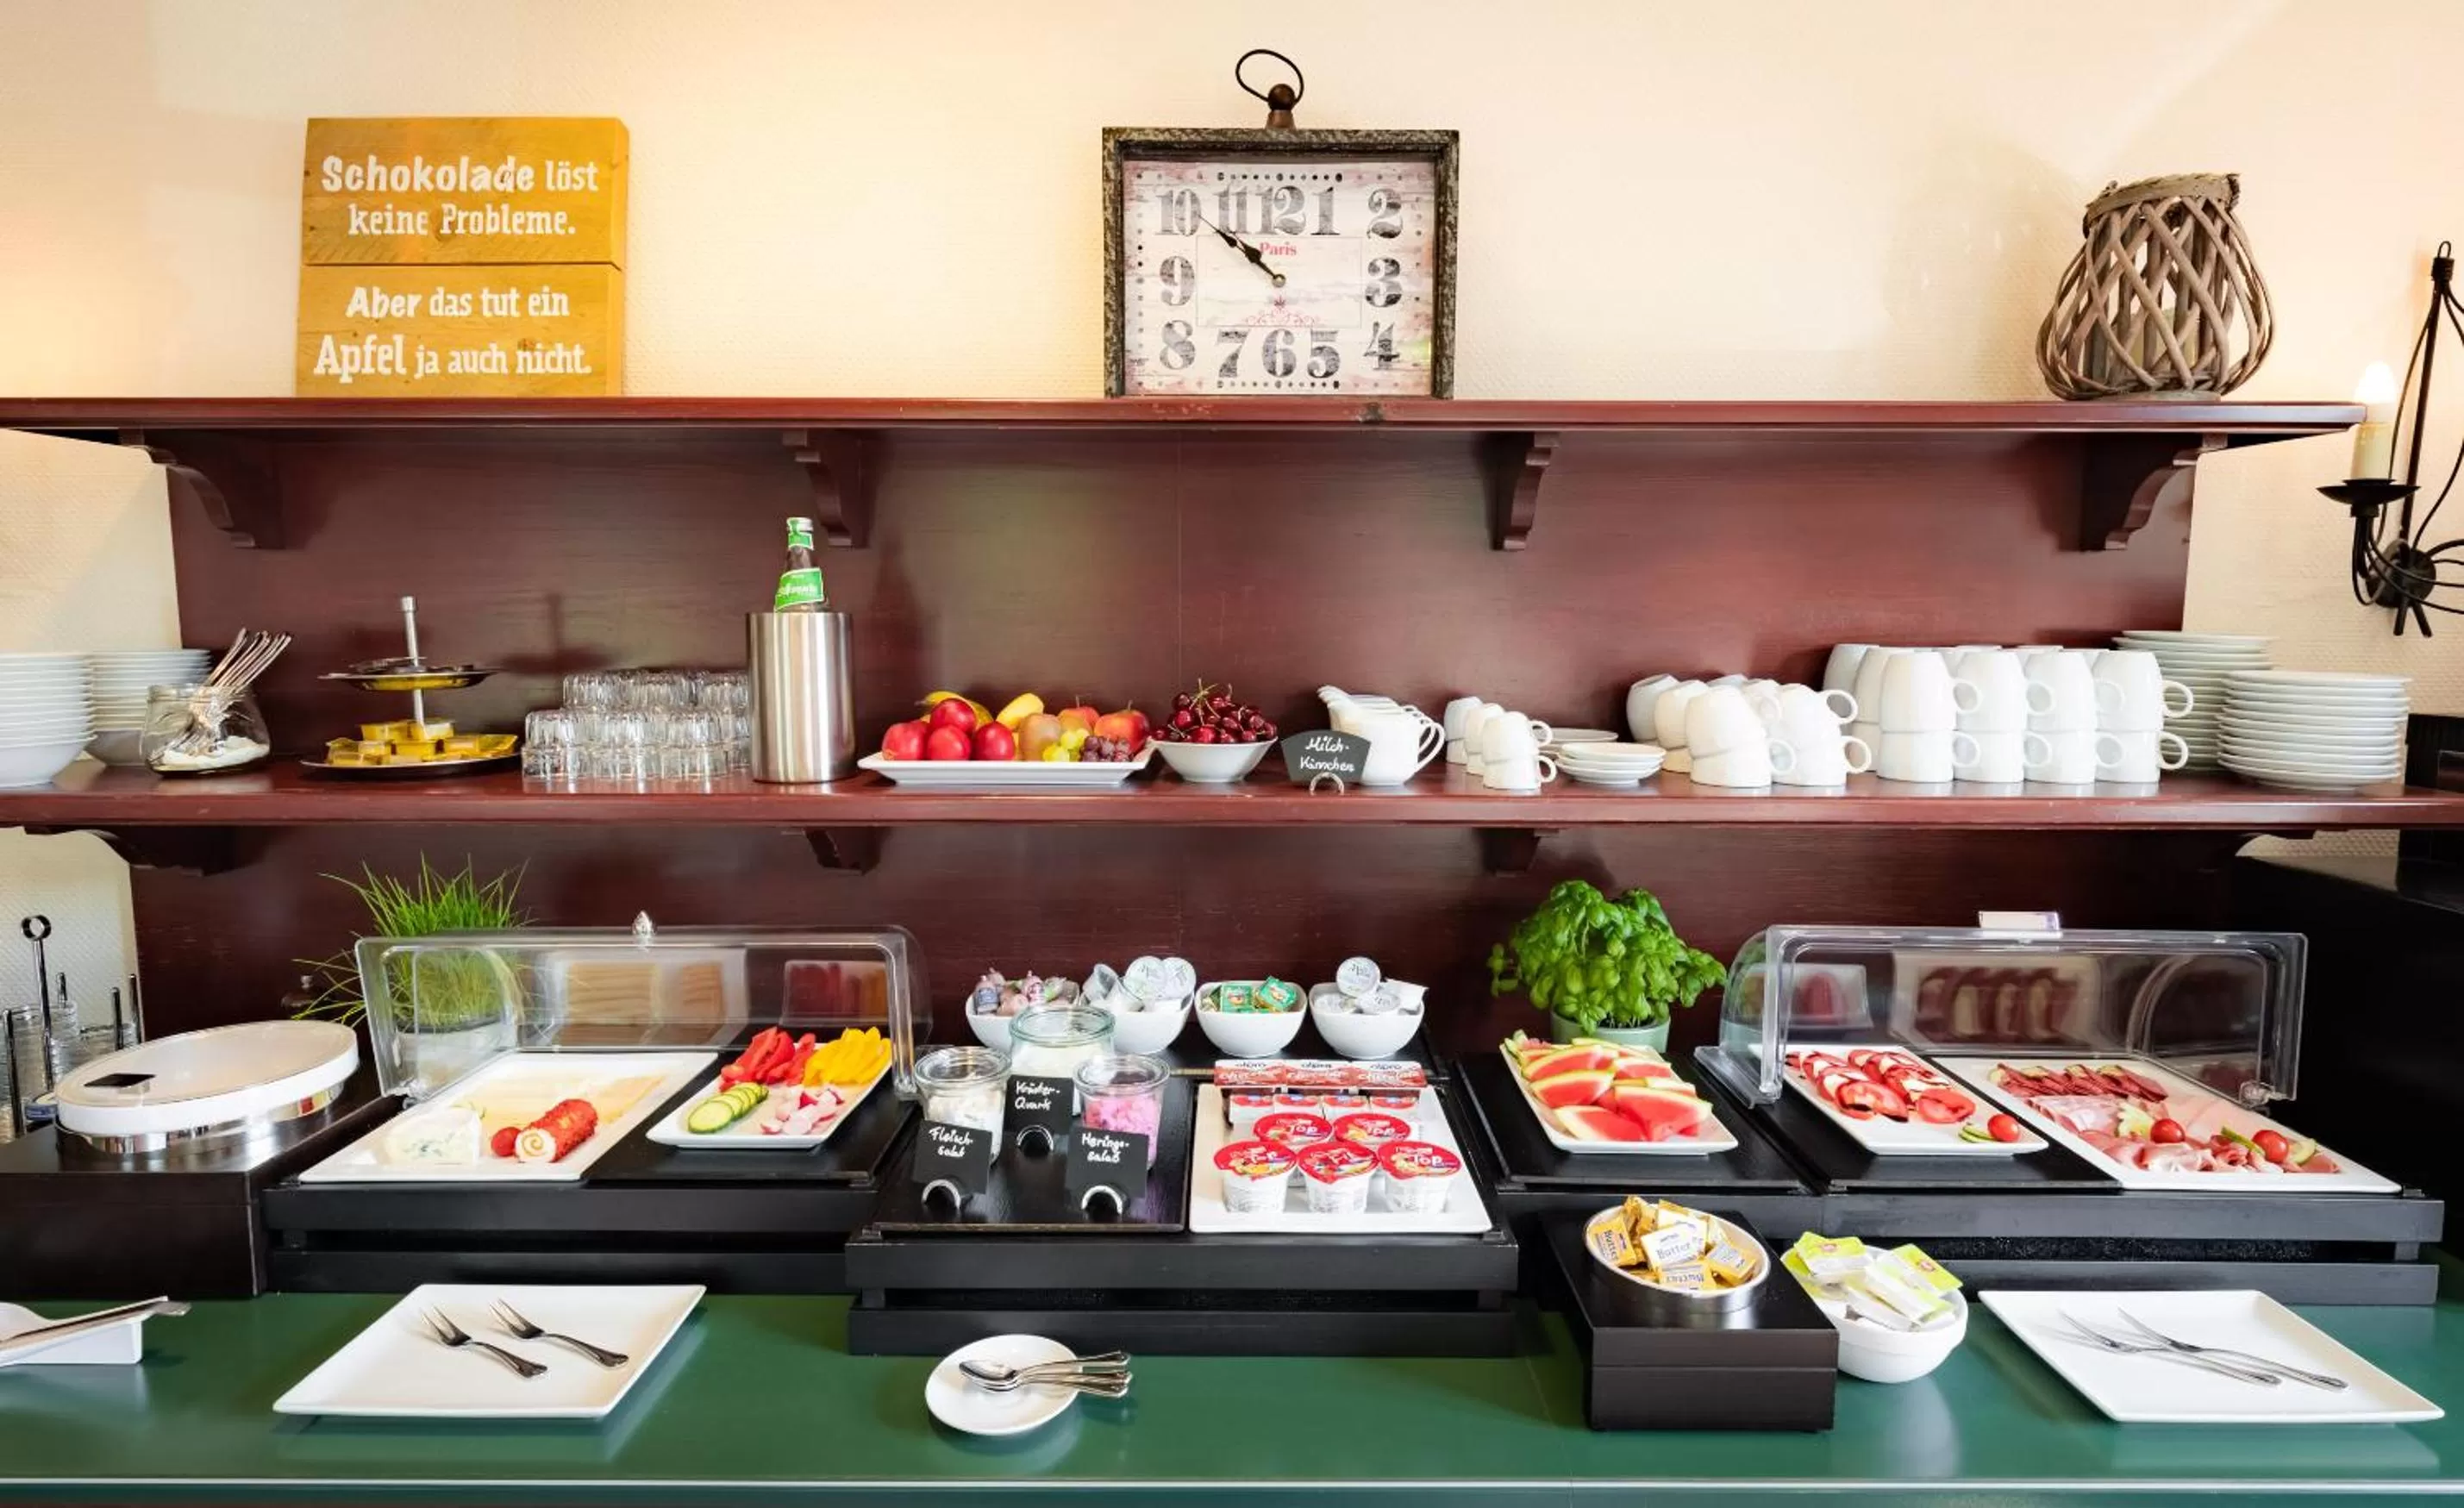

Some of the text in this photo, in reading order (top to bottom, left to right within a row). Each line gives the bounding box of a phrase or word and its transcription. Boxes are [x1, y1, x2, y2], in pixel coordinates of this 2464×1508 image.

[322, 155, 599, 192] Schokolade löst
[348, 203, 576, 235] keine Probleme.
[1154, 188, 1202, 237] 10
[1254, 185, 1307, 235] 12
[1310, 186, 1341, 235] 1
[1366, 188, 1404, 239] 2
[1260, 241, 1297, 256] Paris
[347, 285, 570, 318] Aber das tut ein
[1159, 256, 1195, 306] 9
[1365, 257, 1403, 308] 3
[314, 335, 592, 384] Apfel ja auch nicht.
[1159, 320, 1400, 379] 8 7 6 5 4
